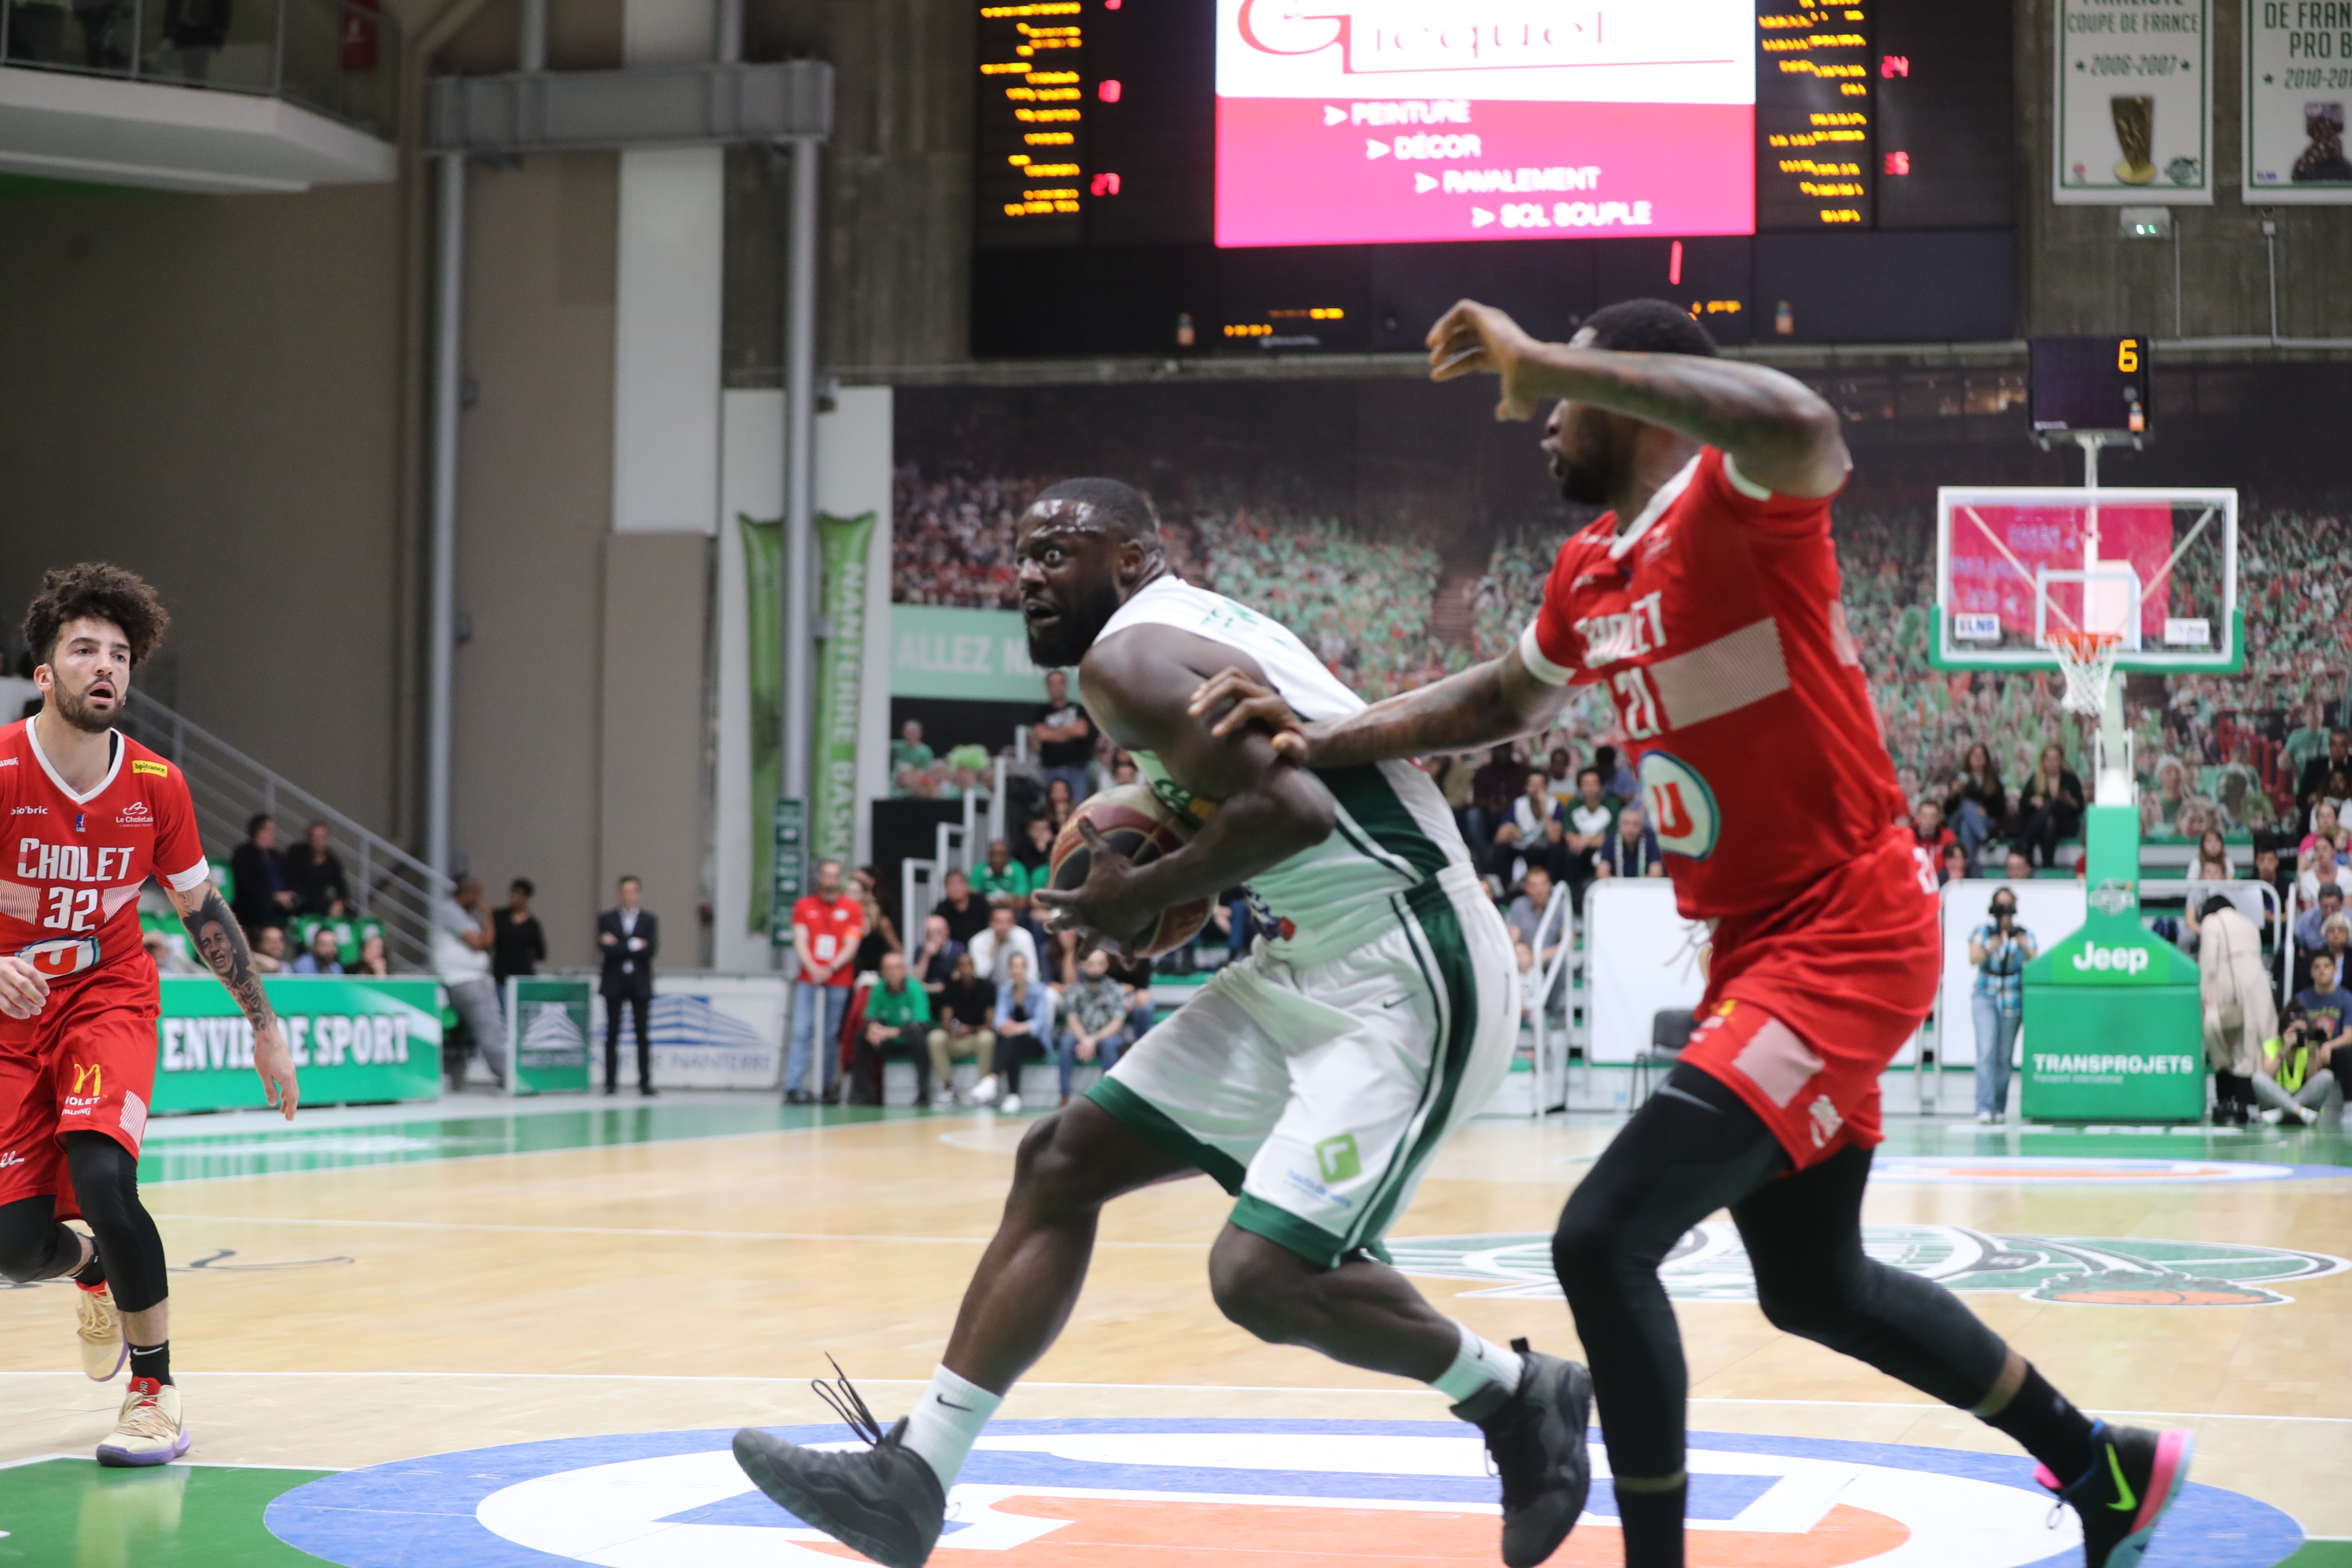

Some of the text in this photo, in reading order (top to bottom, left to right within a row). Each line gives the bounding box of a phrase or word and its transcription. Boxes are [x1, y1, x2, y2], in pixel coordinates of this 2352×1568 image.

[2067, 12, 2199, 34] COUPE DE FRANCE
[2265, 3, 2289, 29] DE
[2290, 31, 2352, 58] PRO B
[1881, 55, 1909, 78] 24
[2090, 53, 2177, 77] 2006-2007
[1351, 99, 1471, 126] PEINTURE
[1394, 131, 1482, 160] DÉCOR
[1442, 166, 1602, 194] RAVALEMENT
[1500, 200, 1653, 229] SOL SOUPLE
[2118, 339, 2138, 373] 6
[833, 561, 865, 744] NANTERRE
[896, 633, 990, 674] ALLEZ
[1614, 666, 1663, 741] 21
[135, 763, 166, 773] bpifrance
[17, 838, 135, 882] CHOLET
[43, 886, 98, 931] 32
[2072, 940, 2149, 976] Jeep
[314, 1014, 409, 1066] SPORT
[2033, 1053, 2194, 1074] TRANSPROJETS
[61, 1107, 92, 1116] PALDING
